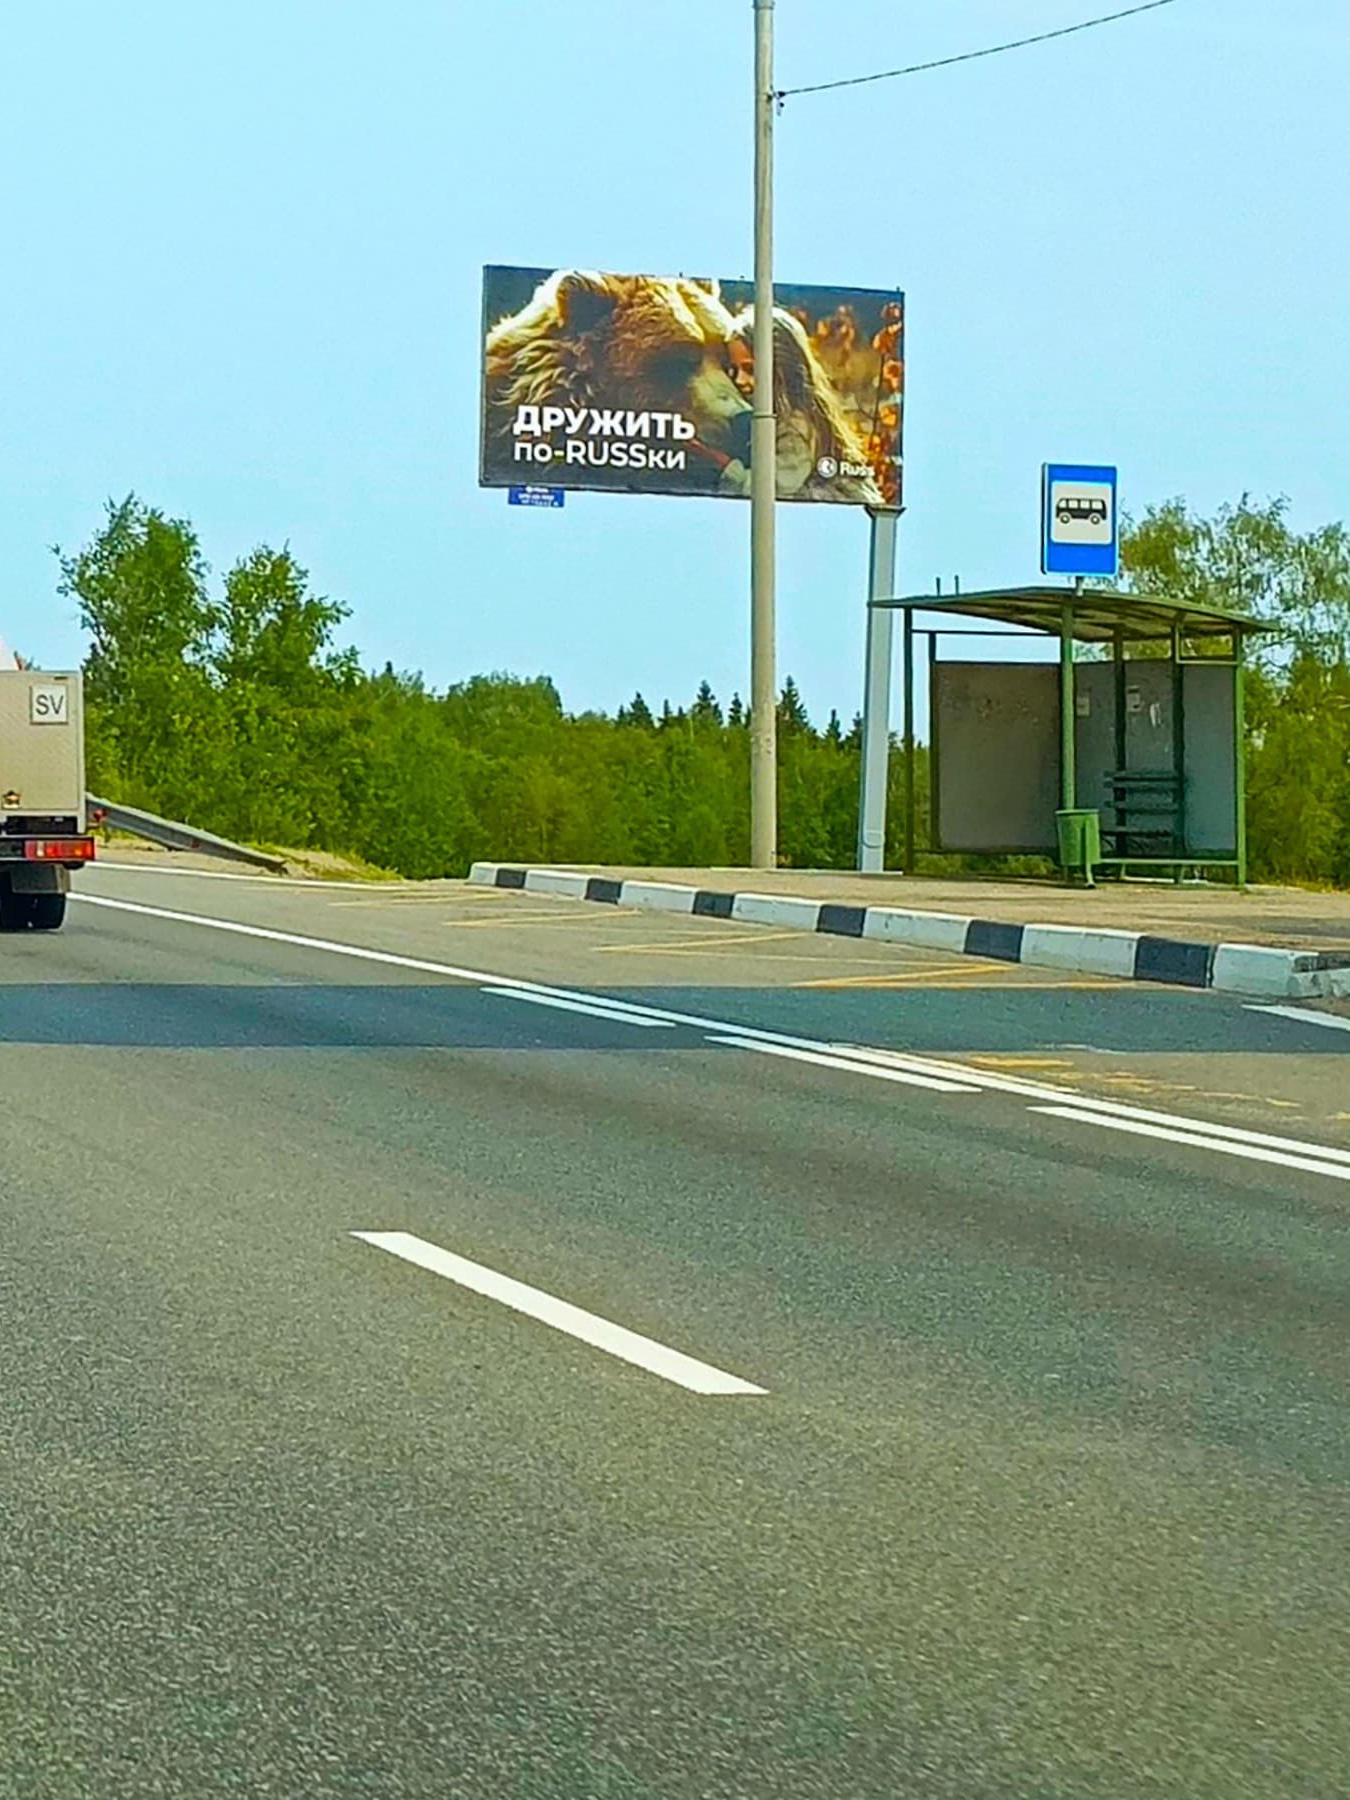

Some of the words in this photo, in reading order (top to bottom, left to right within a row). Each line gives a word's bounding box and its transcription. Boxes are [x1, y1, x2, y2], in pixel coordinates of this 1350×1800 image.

[513, 405, 696, 440] ДРУЖИТЬ
[514, 439, 686, 470] по-RUSSки
[36, 694, 64, 715] SV
